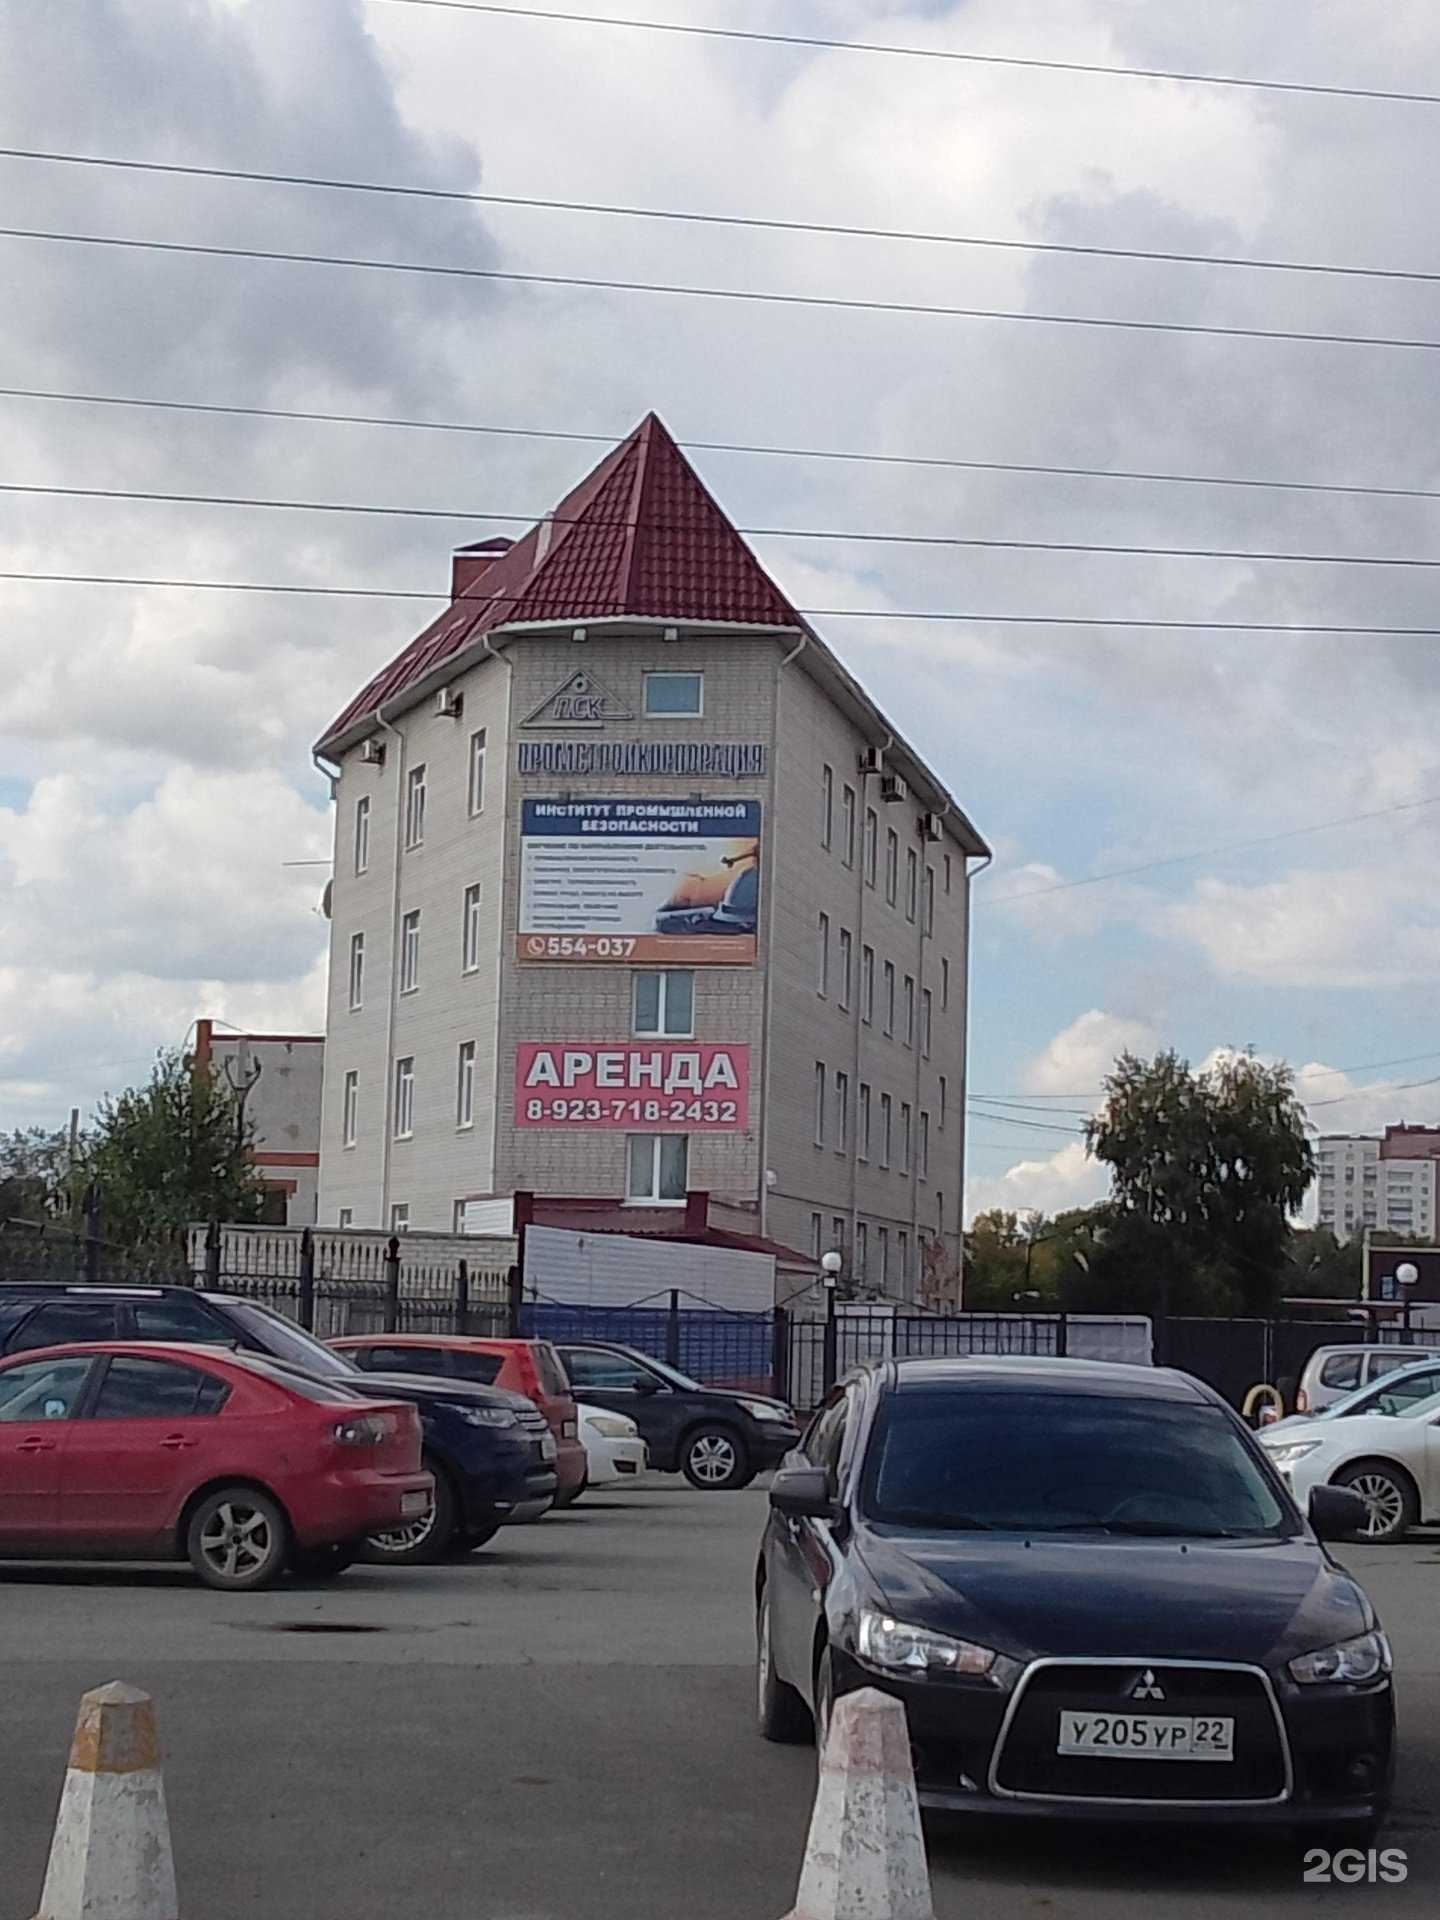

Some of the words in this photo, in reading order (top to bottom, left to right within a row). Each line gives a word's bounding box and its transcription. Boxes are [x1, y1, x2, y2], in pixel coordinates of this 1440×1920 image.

[552, 696, 600, 719] ПСК
[535, 804, 611, 817] ИНСТИТУТ
[616, 803, 747, 818] ПРОМЫШЛЕННОЙ
[581, 820, 699, 833] БЕЗОПАСНОСТИ
[547, 938, 637, 957] 554-037
[525, 1052, 739, 1095] АРЕНДА
[527, 1100, 737, 1122] 8-923-718-2432
[1195, 1720, 1225, 1742] 22
